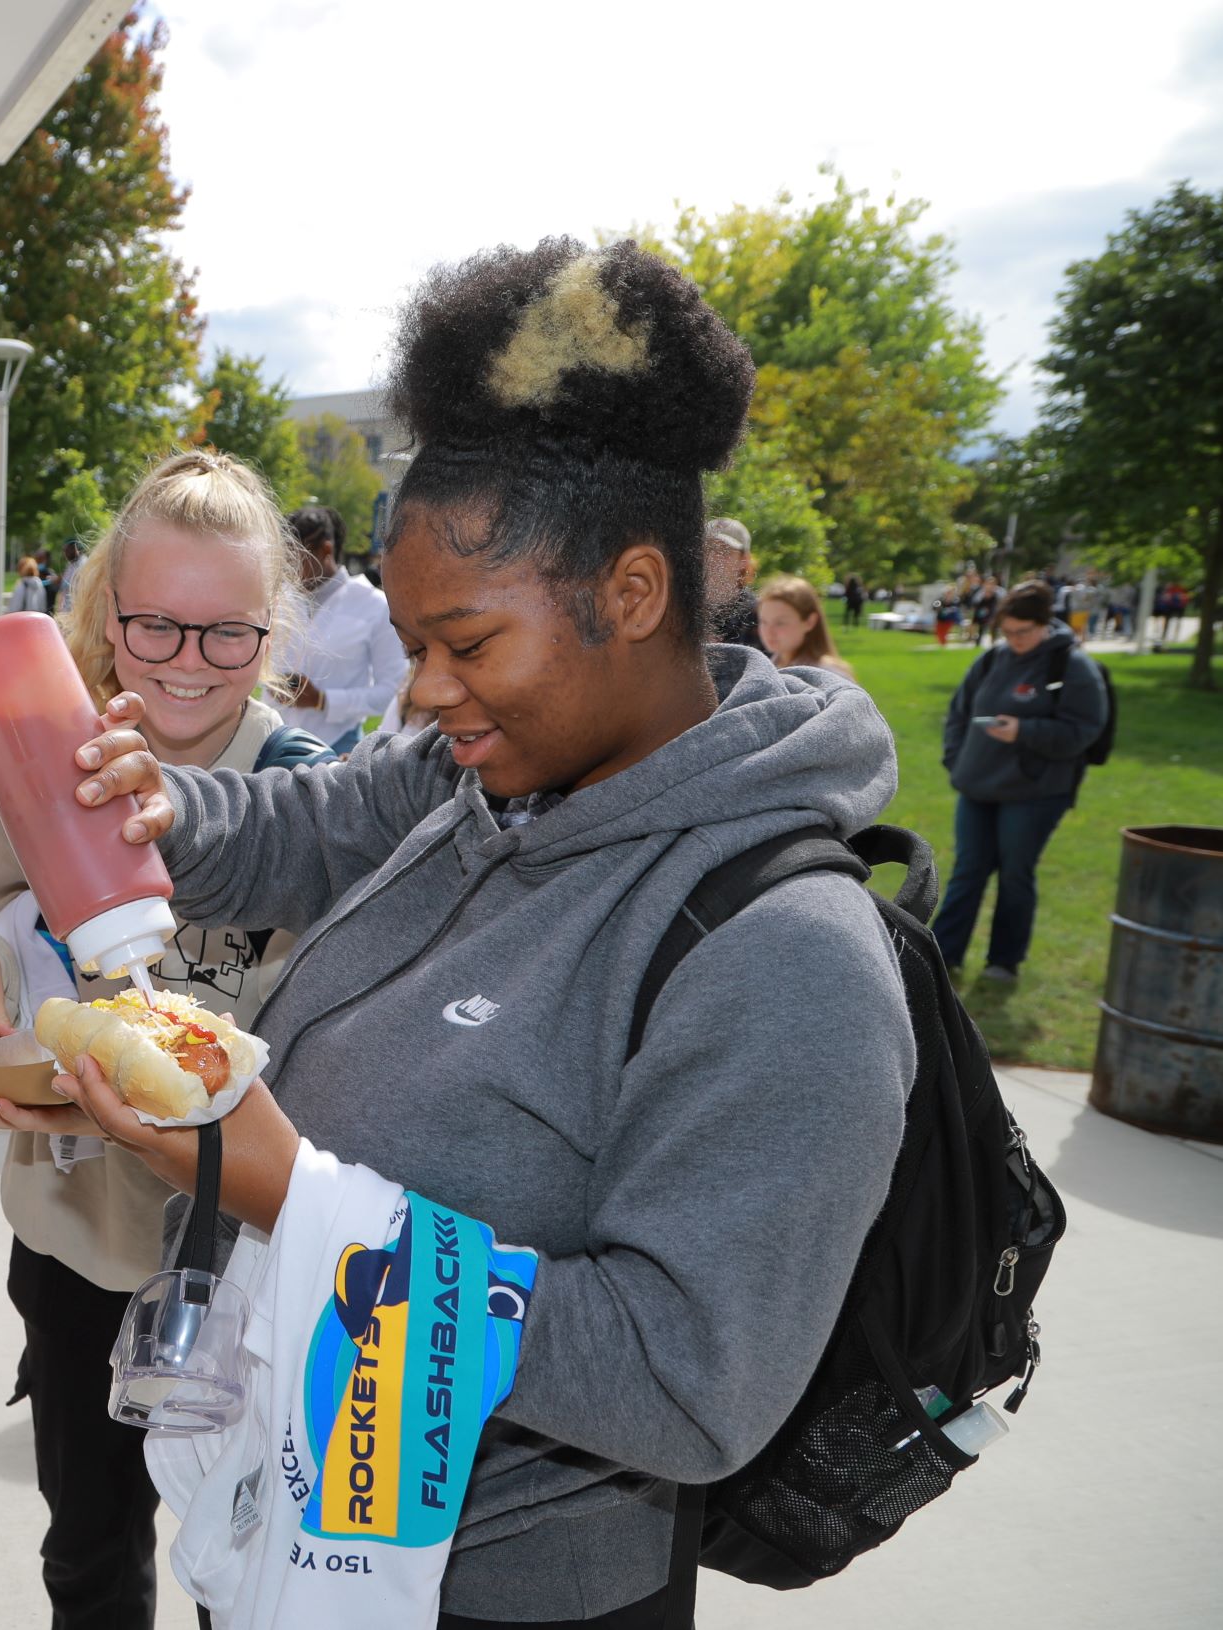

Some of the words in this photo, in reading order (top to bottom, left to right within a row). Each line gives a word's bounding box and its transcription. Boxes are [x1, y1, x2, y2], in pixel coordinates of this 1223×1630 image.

[349, 1313, 382, 1525] ROCKETS
[421, 1228, 461, 1510] FLASHBACK
[326, 1554, 373, 1575] 150
